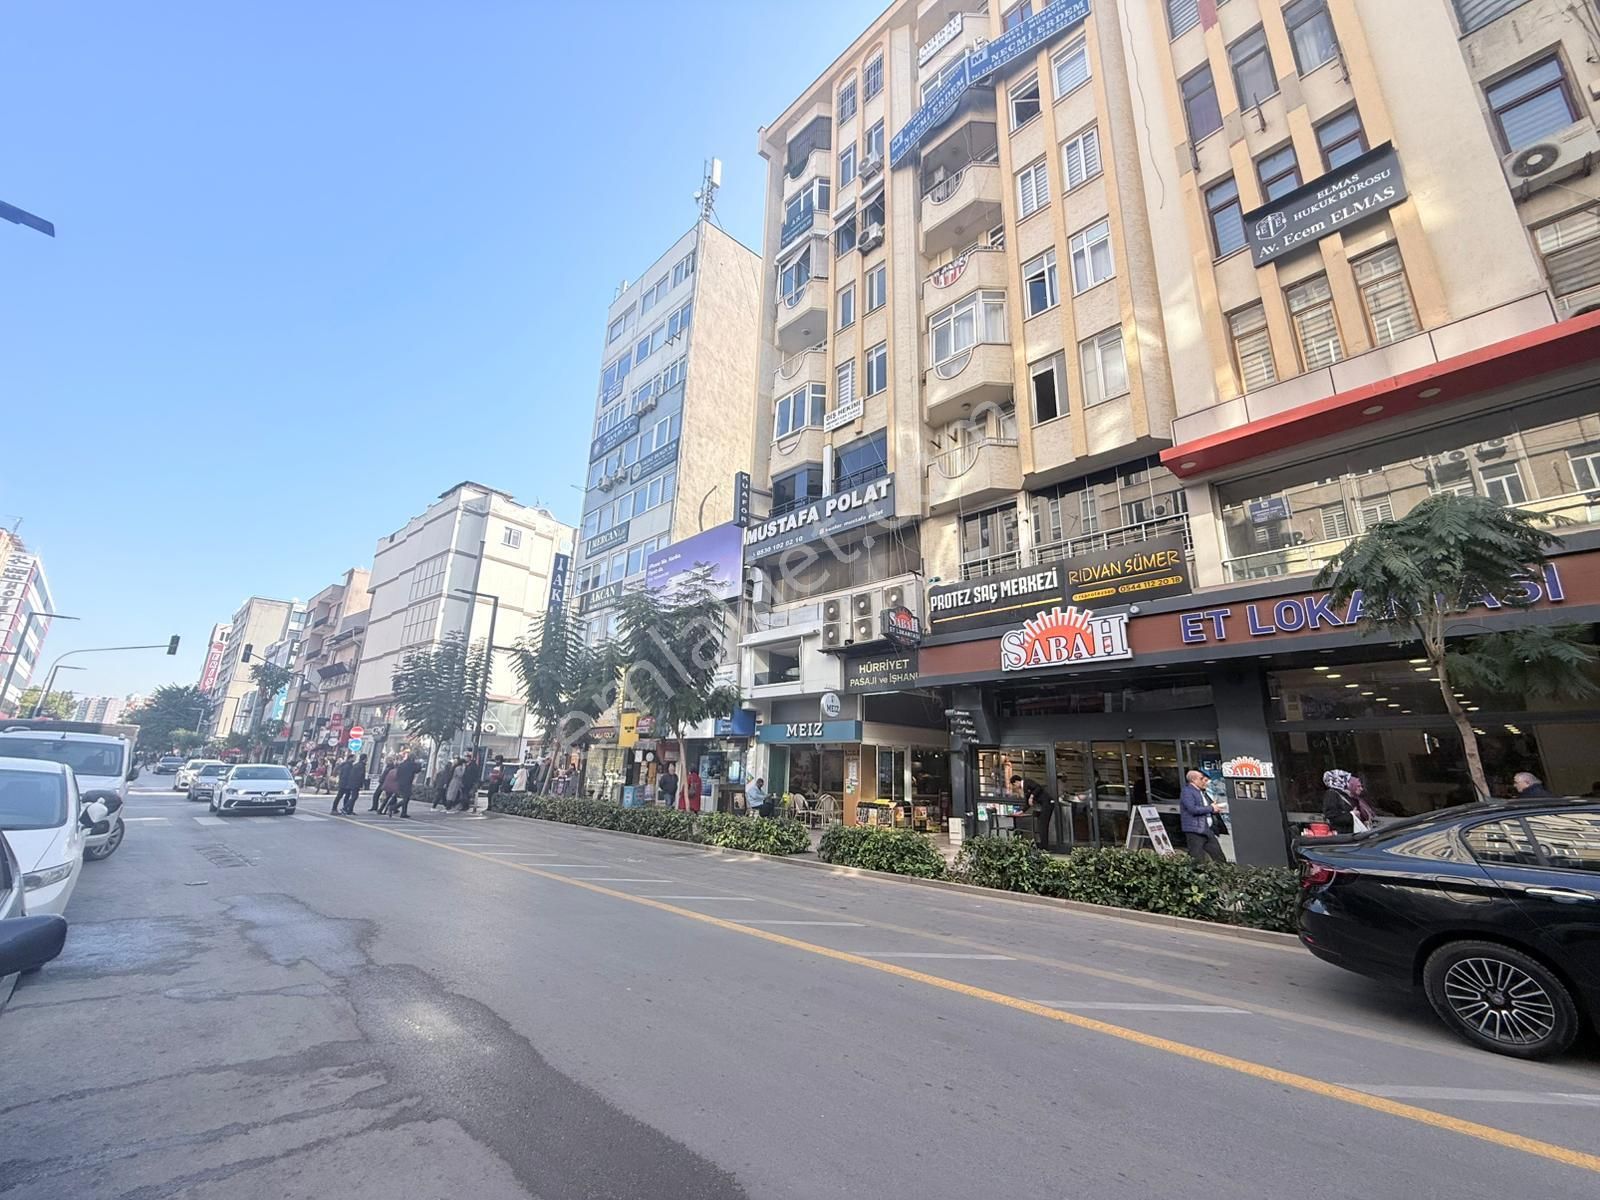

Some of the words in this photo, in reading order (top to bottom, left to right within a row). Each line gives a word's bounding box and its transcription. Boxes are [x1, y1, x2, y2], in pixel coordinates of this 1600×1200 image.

[991, 32, 1033, 62] NECMİ
[1037, 1, 1086, 34] ERDEM
[932, 77, 965, 115] ERDEM
[1294, 196, 1337, 222] HUKUK
[1339, 168, 1391, 198] BÜROSU
[1317, 174, 1359, 200] ELMAS
[1259, 242, 1279, 258] Av.
[1284, 221, 1326, 247] Ecem
[1331, 186, 1396, 224] ELMAS
[746, 506, 820, 545] MUSTAFA
[826, 478, 892, 518] POLAT
[868, 509, 884, 520] polat
[1068, 560, 1122, 585] RIDVAN
[1125, 550, 1181, 573] SÜMER
[930, 587, 972, 612] PROTEZ
[973, 582, 998, 604] SAÇ
[1000, 566, 1058, 598] MERKEZİ
[1120, 583, 1142, 592] 0544
[1144, 580, 1156, 588] 112
[1158, 578, 1169, 586] 20
[1171, 576, 1181, 584] 18
[889, 611, 919, 633] SABAH
[1180, 608, 1231, 643] ET
[1003, 614, 1131, 670] SABAH
[858, 658, 910, 674] HÜRRİYET
[879, 676, 889, 684] ve
[826, 704, 841, 713] MEIZ
[786, 723, 824, 737] MEIZ
[1222, 761, 1275, 778] SABAH
